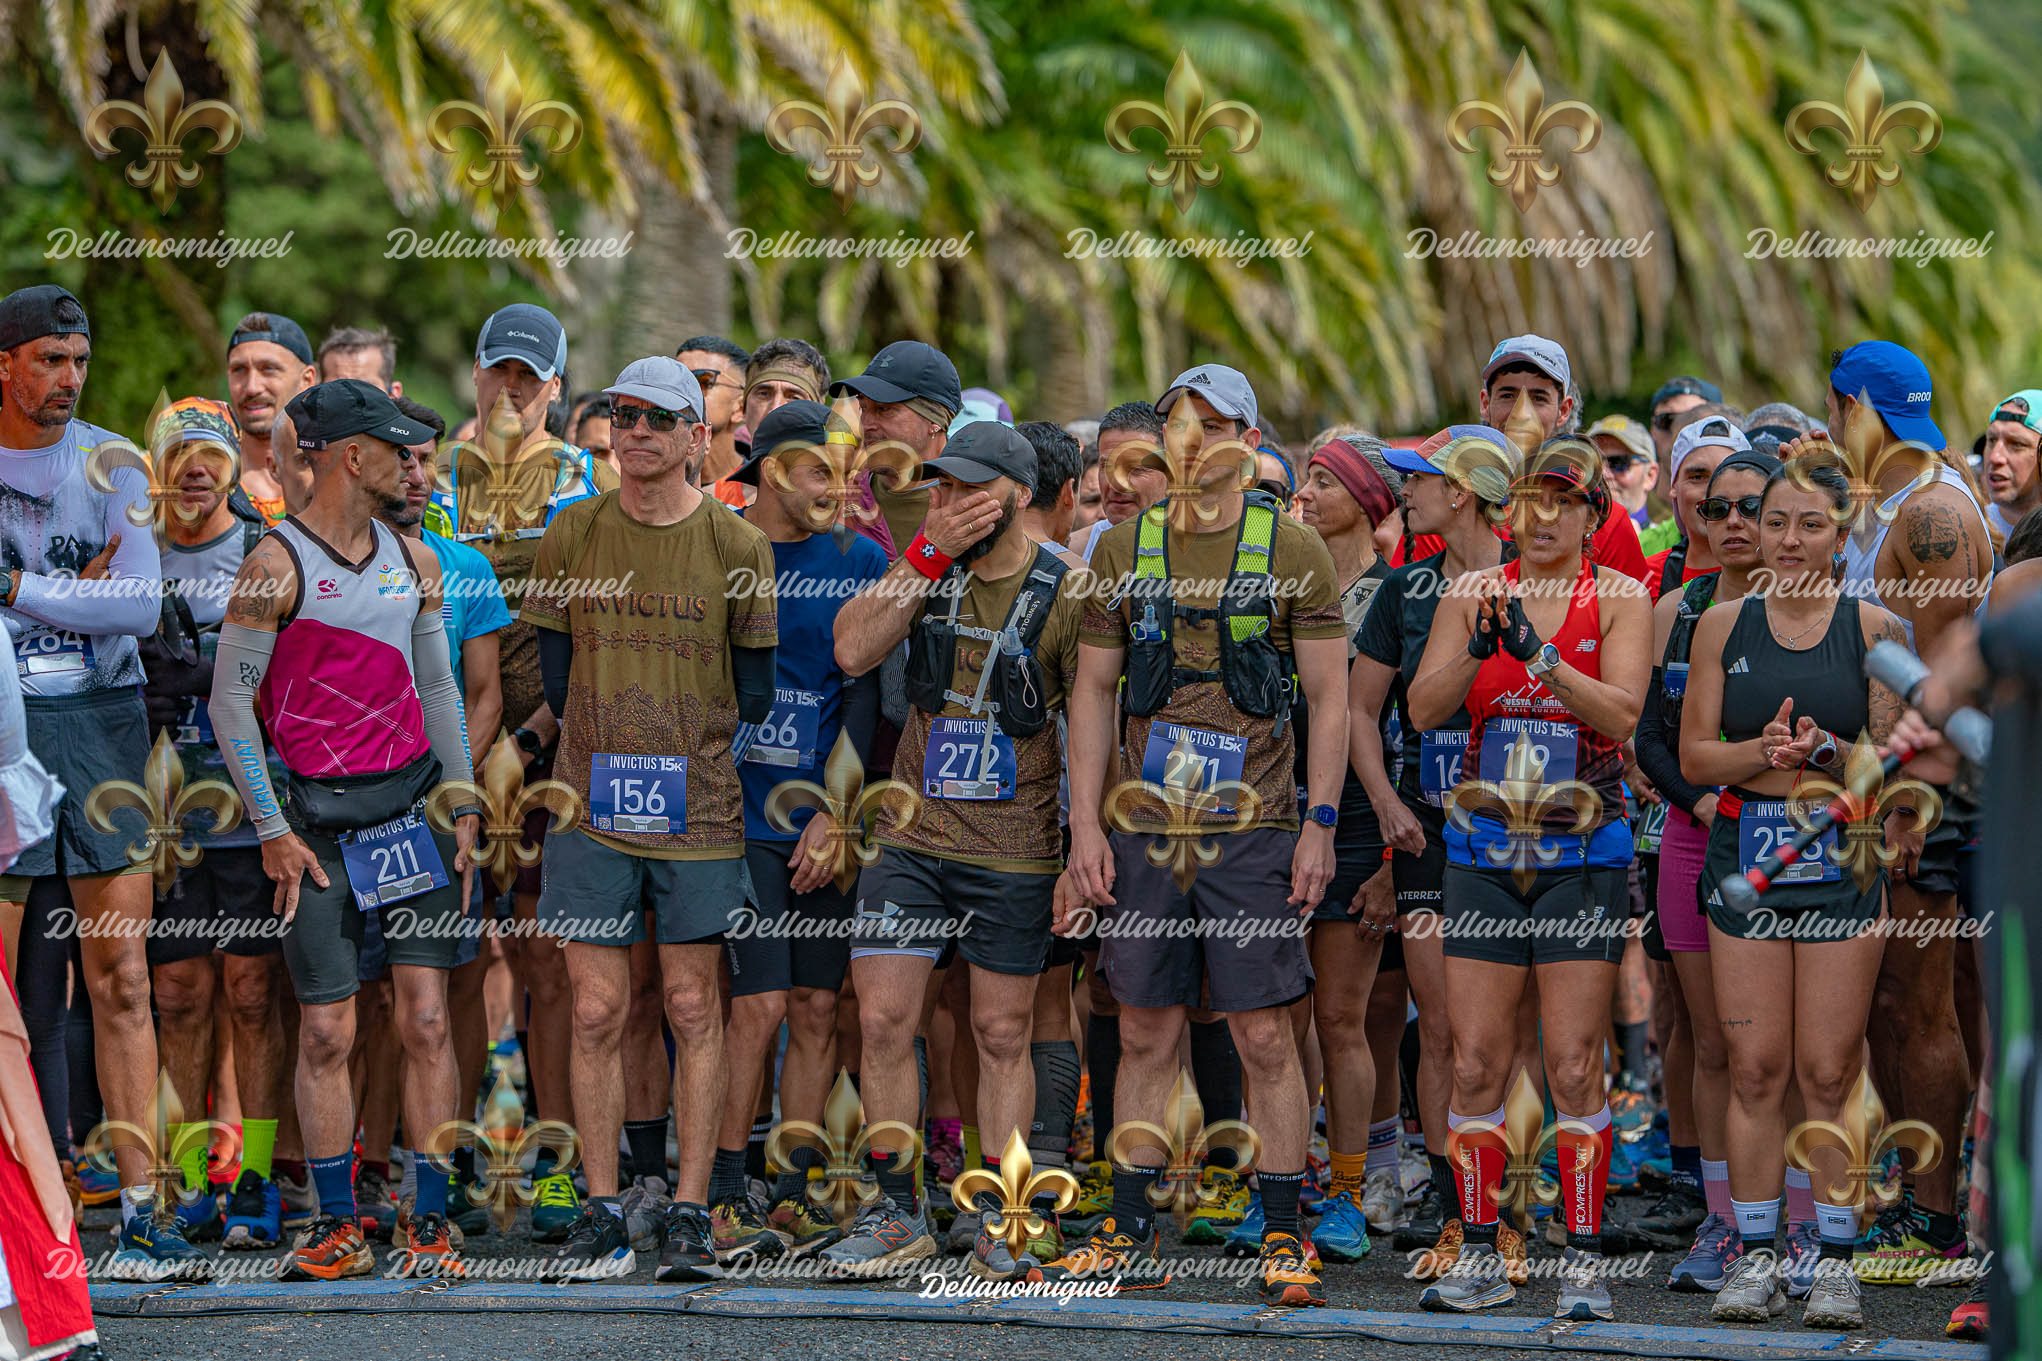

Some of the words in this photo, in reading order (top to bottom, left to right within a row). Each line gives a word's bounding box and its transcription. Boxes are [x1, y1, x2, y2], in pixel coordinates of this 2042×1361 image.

[583, 586, 707, 622] INVICTUS
[796, 691, 818, 707] 15K
[1534, 696, 1563, 707] ARRI
[944, 719, 988, 734] INVICTUS
[1168, 725, 1216, 747] INVICTUS
[1219, 735, 1242, 752] 15K
[1435, 731, 1470, 745] INVICTU
[1501, 719, 1548, 735] INVICTUS
[1550, 722, 1575, 738] 15K
[610, 755, 657, 769] INVICTUS
[659, 757, 683, 772] 15K
[939, 742, 1000, 779] 272
[1163, 750, 1220, 793] 271
[1435, 754, 1462, 789] 16
[1503, 742, 1550, 780] 119
[229, 737, 278, 816] URUGUAY
[609, 778, 666, 815] 156
[1757, 803, 1805, 816] INVICTUS
[357, 819, 404, 843] INVICTUS
[370, 839, 420, 884] 211
[1402, 890, 1442, 900] TERREX
[1459, 1146, 1474, 1223] COMPRESSPORT
[1575, 1146, 1588, 1224] COMPRESSPORT
